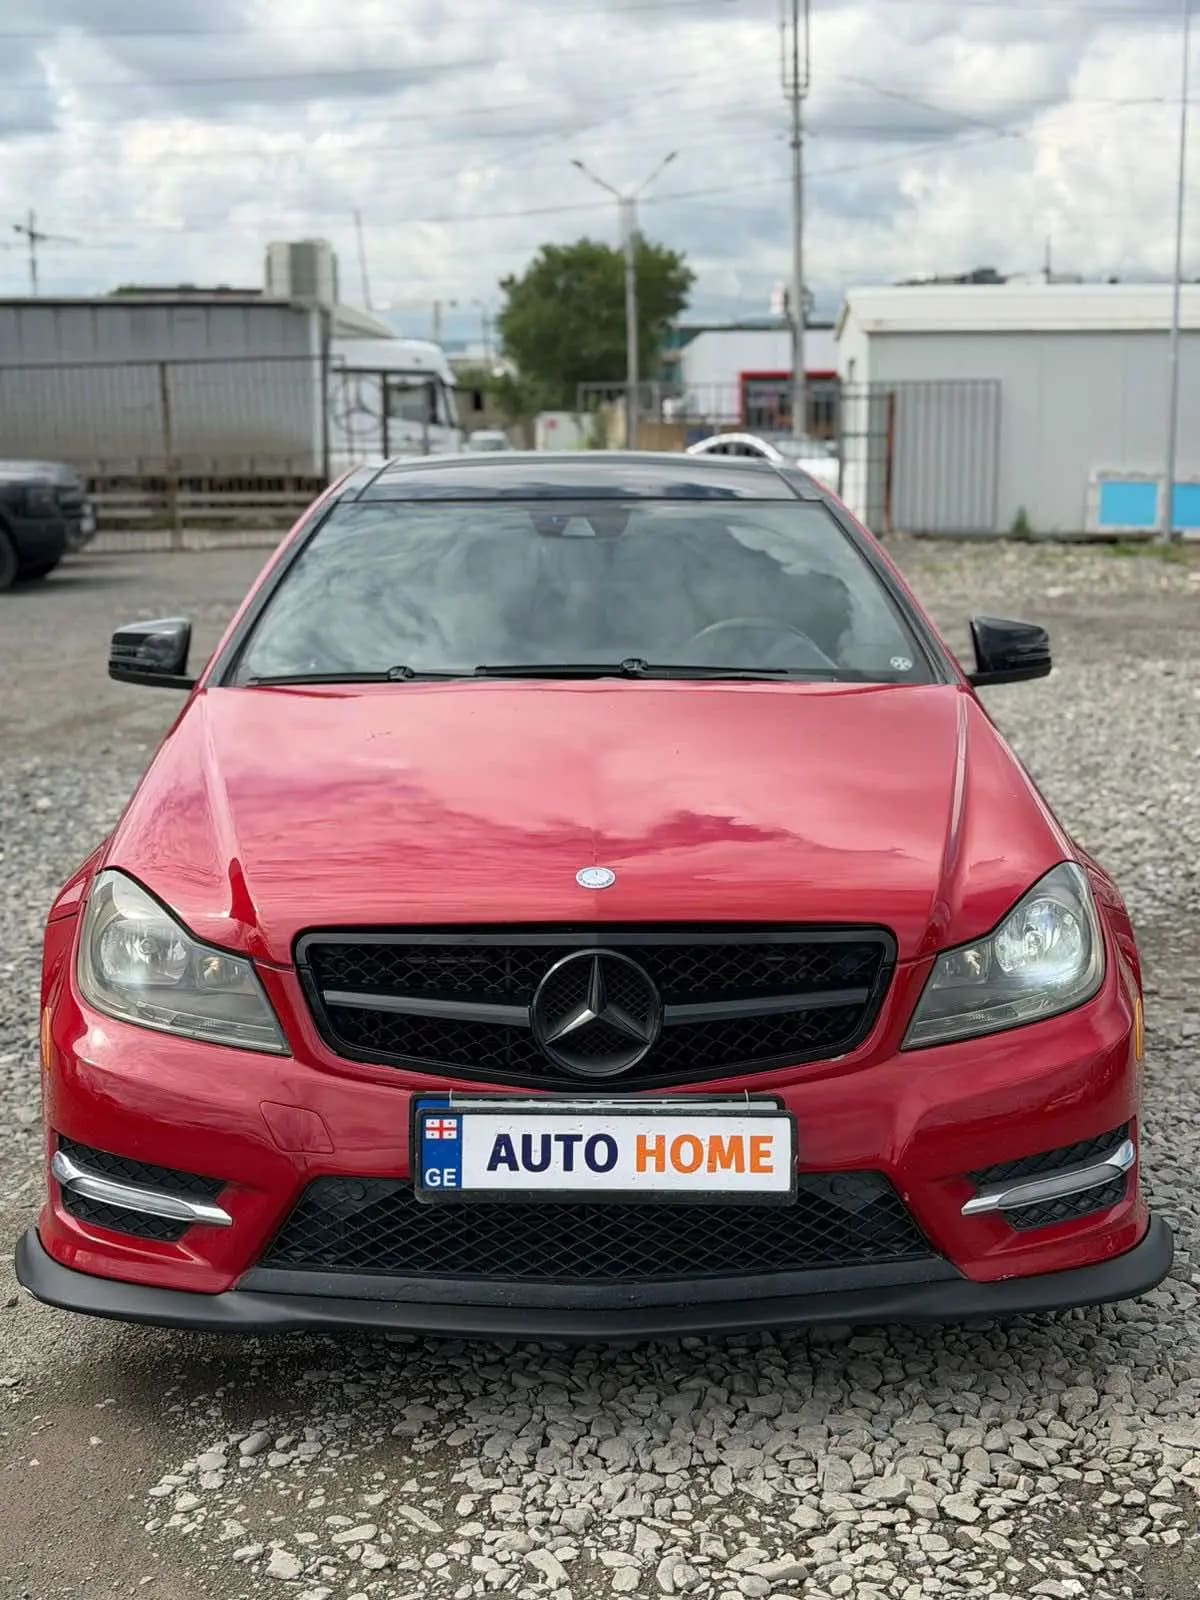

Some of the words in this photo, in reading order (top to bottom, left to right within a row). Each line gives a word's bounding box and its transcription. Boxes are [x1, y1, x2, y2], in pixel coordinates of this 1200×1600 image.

[486, 1133, 619, 1173] AUTO
[635, 1134, 775, 1174] HOME
[425, 1168, 457, 1188] GE
